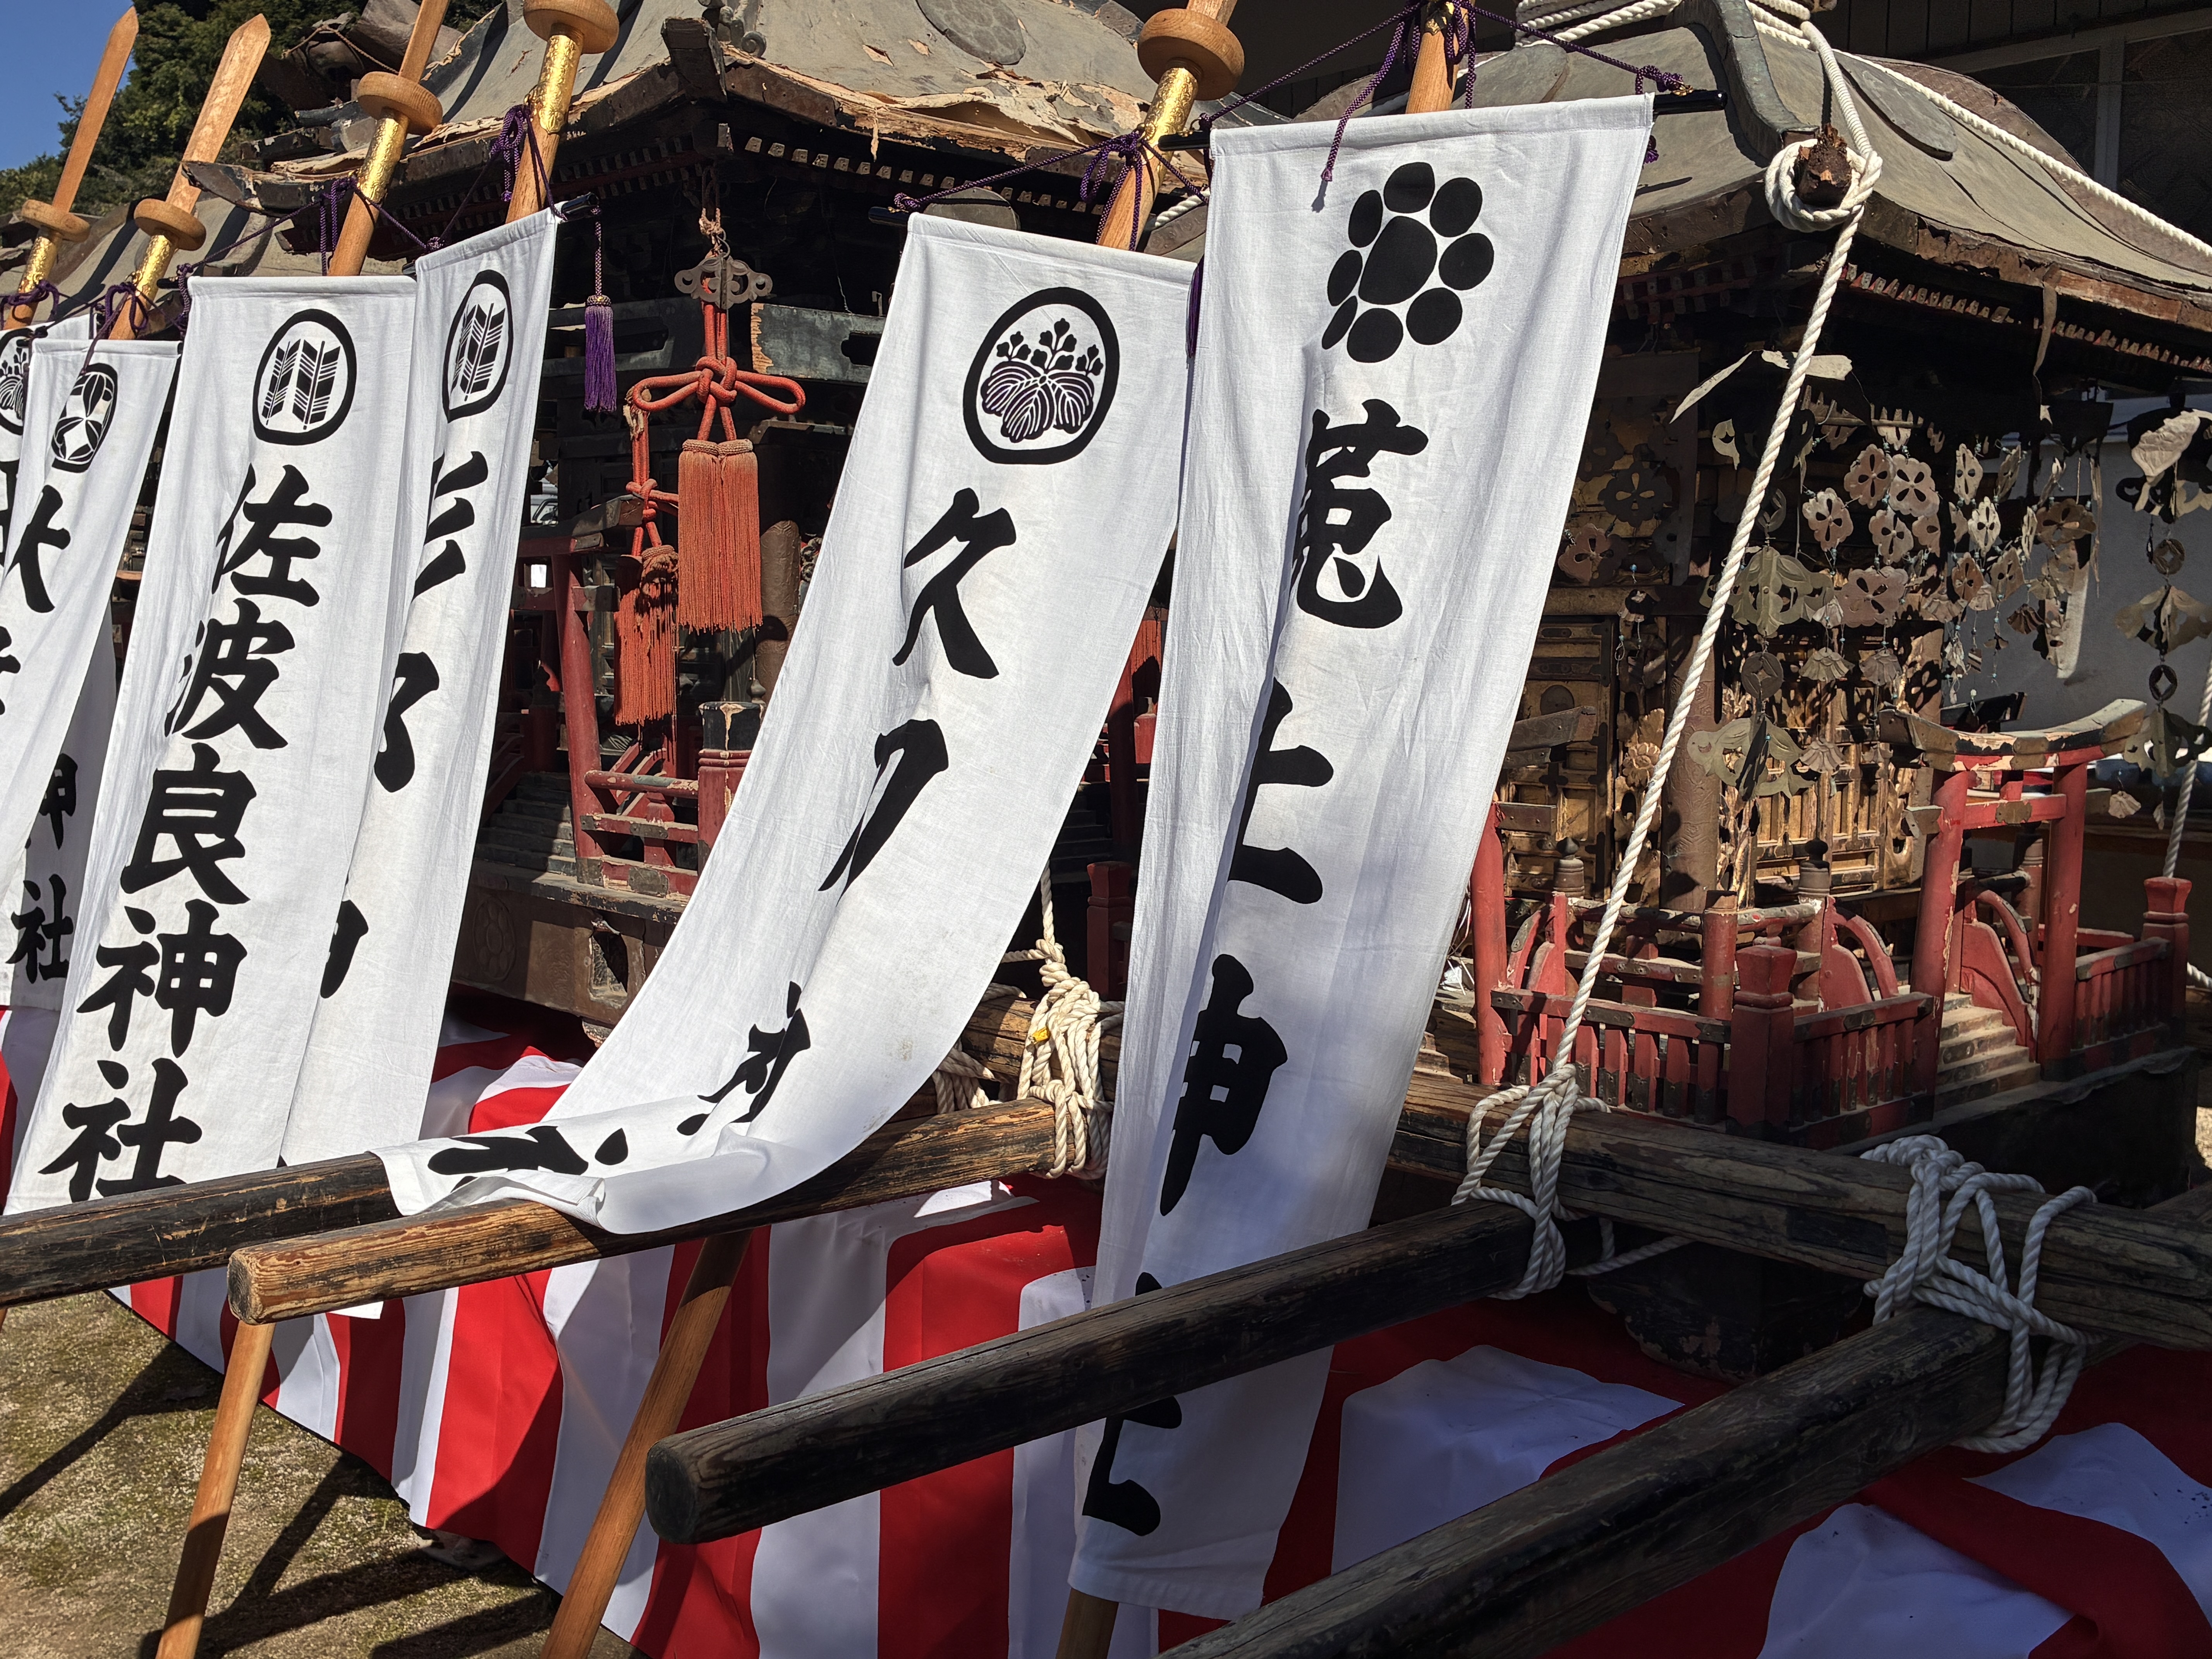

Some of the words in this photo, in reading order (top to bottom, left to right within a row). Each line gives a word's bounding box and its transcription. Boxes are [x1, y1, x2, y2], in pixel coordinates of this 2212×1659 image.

[39, 464, 332, 1203] 佐波良神社
